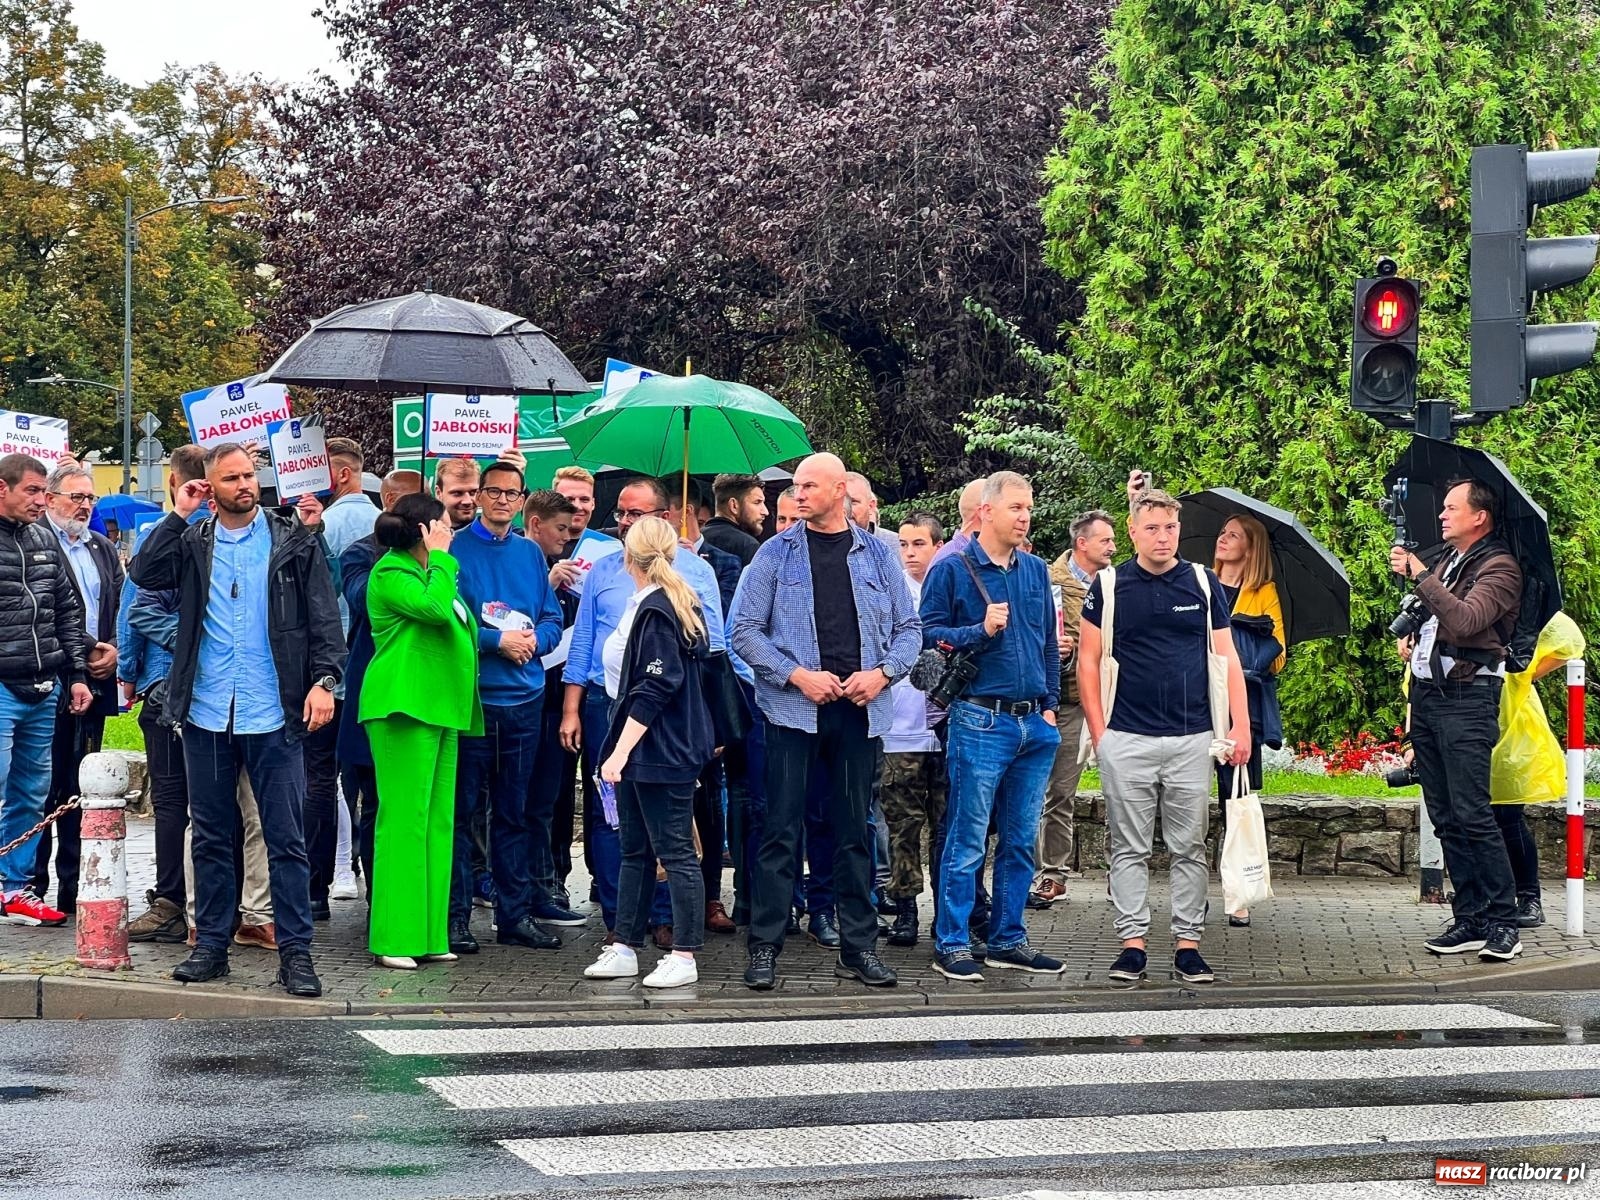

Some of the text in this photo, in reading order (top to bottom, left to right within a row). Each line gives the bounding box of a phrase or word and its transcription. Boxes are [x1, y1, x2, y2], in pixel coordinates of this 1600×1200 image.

[220, 401, 261, 418] PAWEŁ
[455, 408, 491, 418] PAWEŁ
[199, 408, 287, 440] JABŁOŃSKI
[432, 419, 512, 434] JABŁOŃSKI
[6, 432, 43, 445] PAWEŁ
[287, 442, 312, 456] PAWEŁ
[277, 454, 327, 475] JABŁOŃSKI
